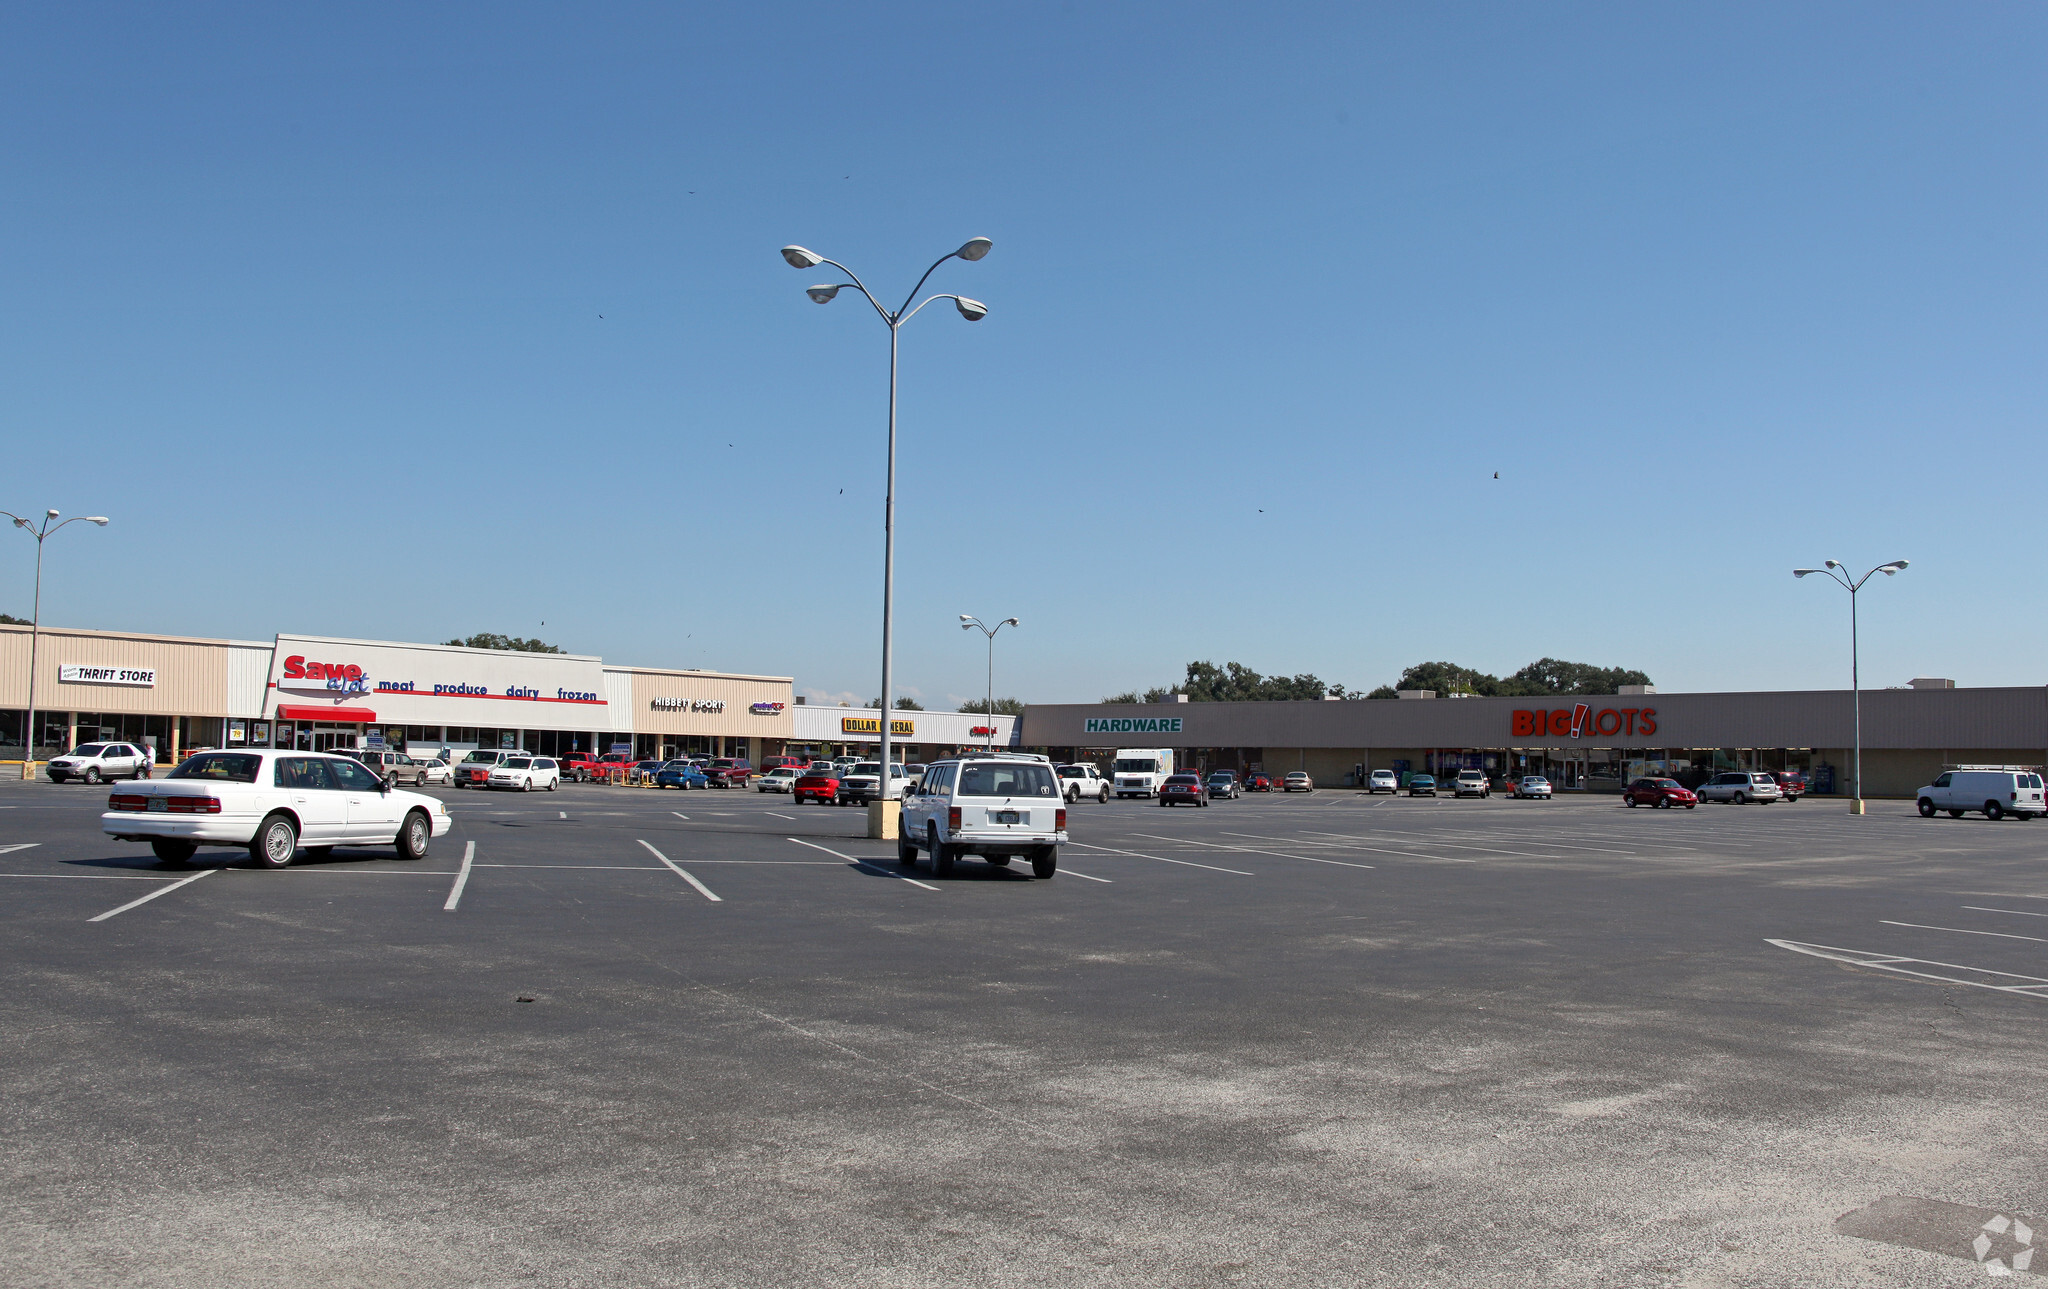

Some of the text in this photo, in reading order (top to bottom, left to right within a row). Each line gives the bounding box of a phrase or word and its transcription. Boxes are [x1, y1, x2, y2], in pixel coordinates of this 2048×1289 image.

[284, 655, 362, 681] Save
[79, 668, 154, 682] THRIFT STORE
[328, 677, 341, 689] a
[379, 681, 597, 701] meat produce dairy frozen
[655, 697, 727, 709] HIBBETT SPORTS
[846, 720, 914, 733] DOLLAR NERAL
[1087, 719, 1181, 732] HARDWARE
[1584, 709, 1657, 736] LOTS
